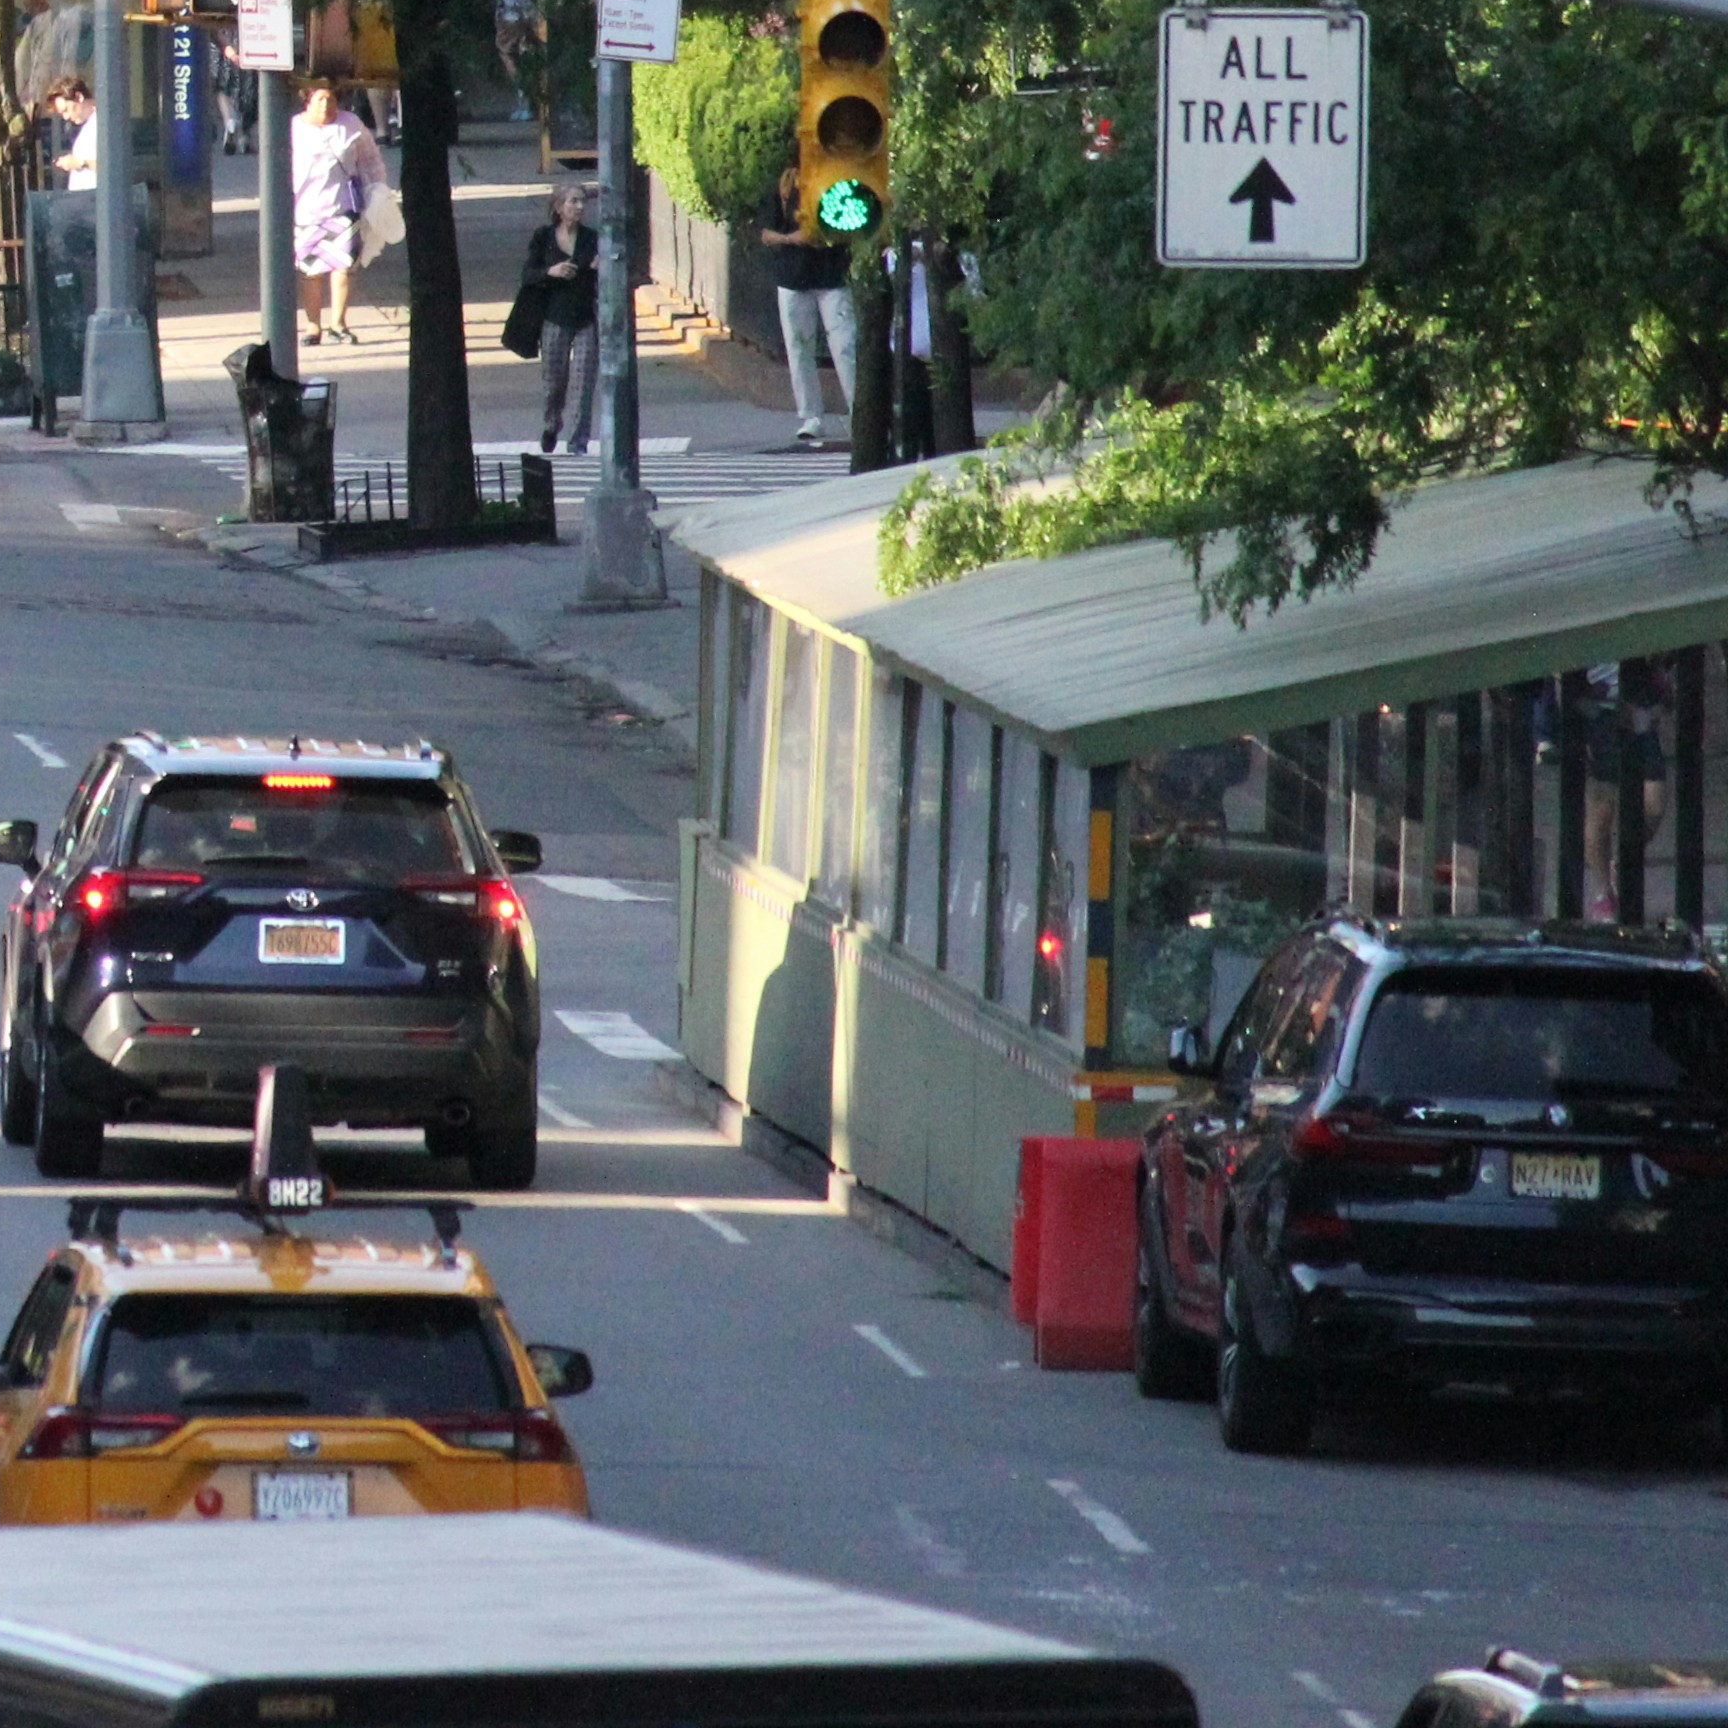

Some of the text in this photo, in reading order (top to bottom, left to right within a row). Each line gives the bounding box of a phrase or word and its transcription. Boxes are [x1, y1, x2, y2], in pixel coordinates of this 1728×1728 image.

[174, 37, 190, 57] 21
[1220, 35, 1308, 80] ALL
[174, 64, 191, 120] Street
[1179, 101, 1349, 145] TRAFFIC
